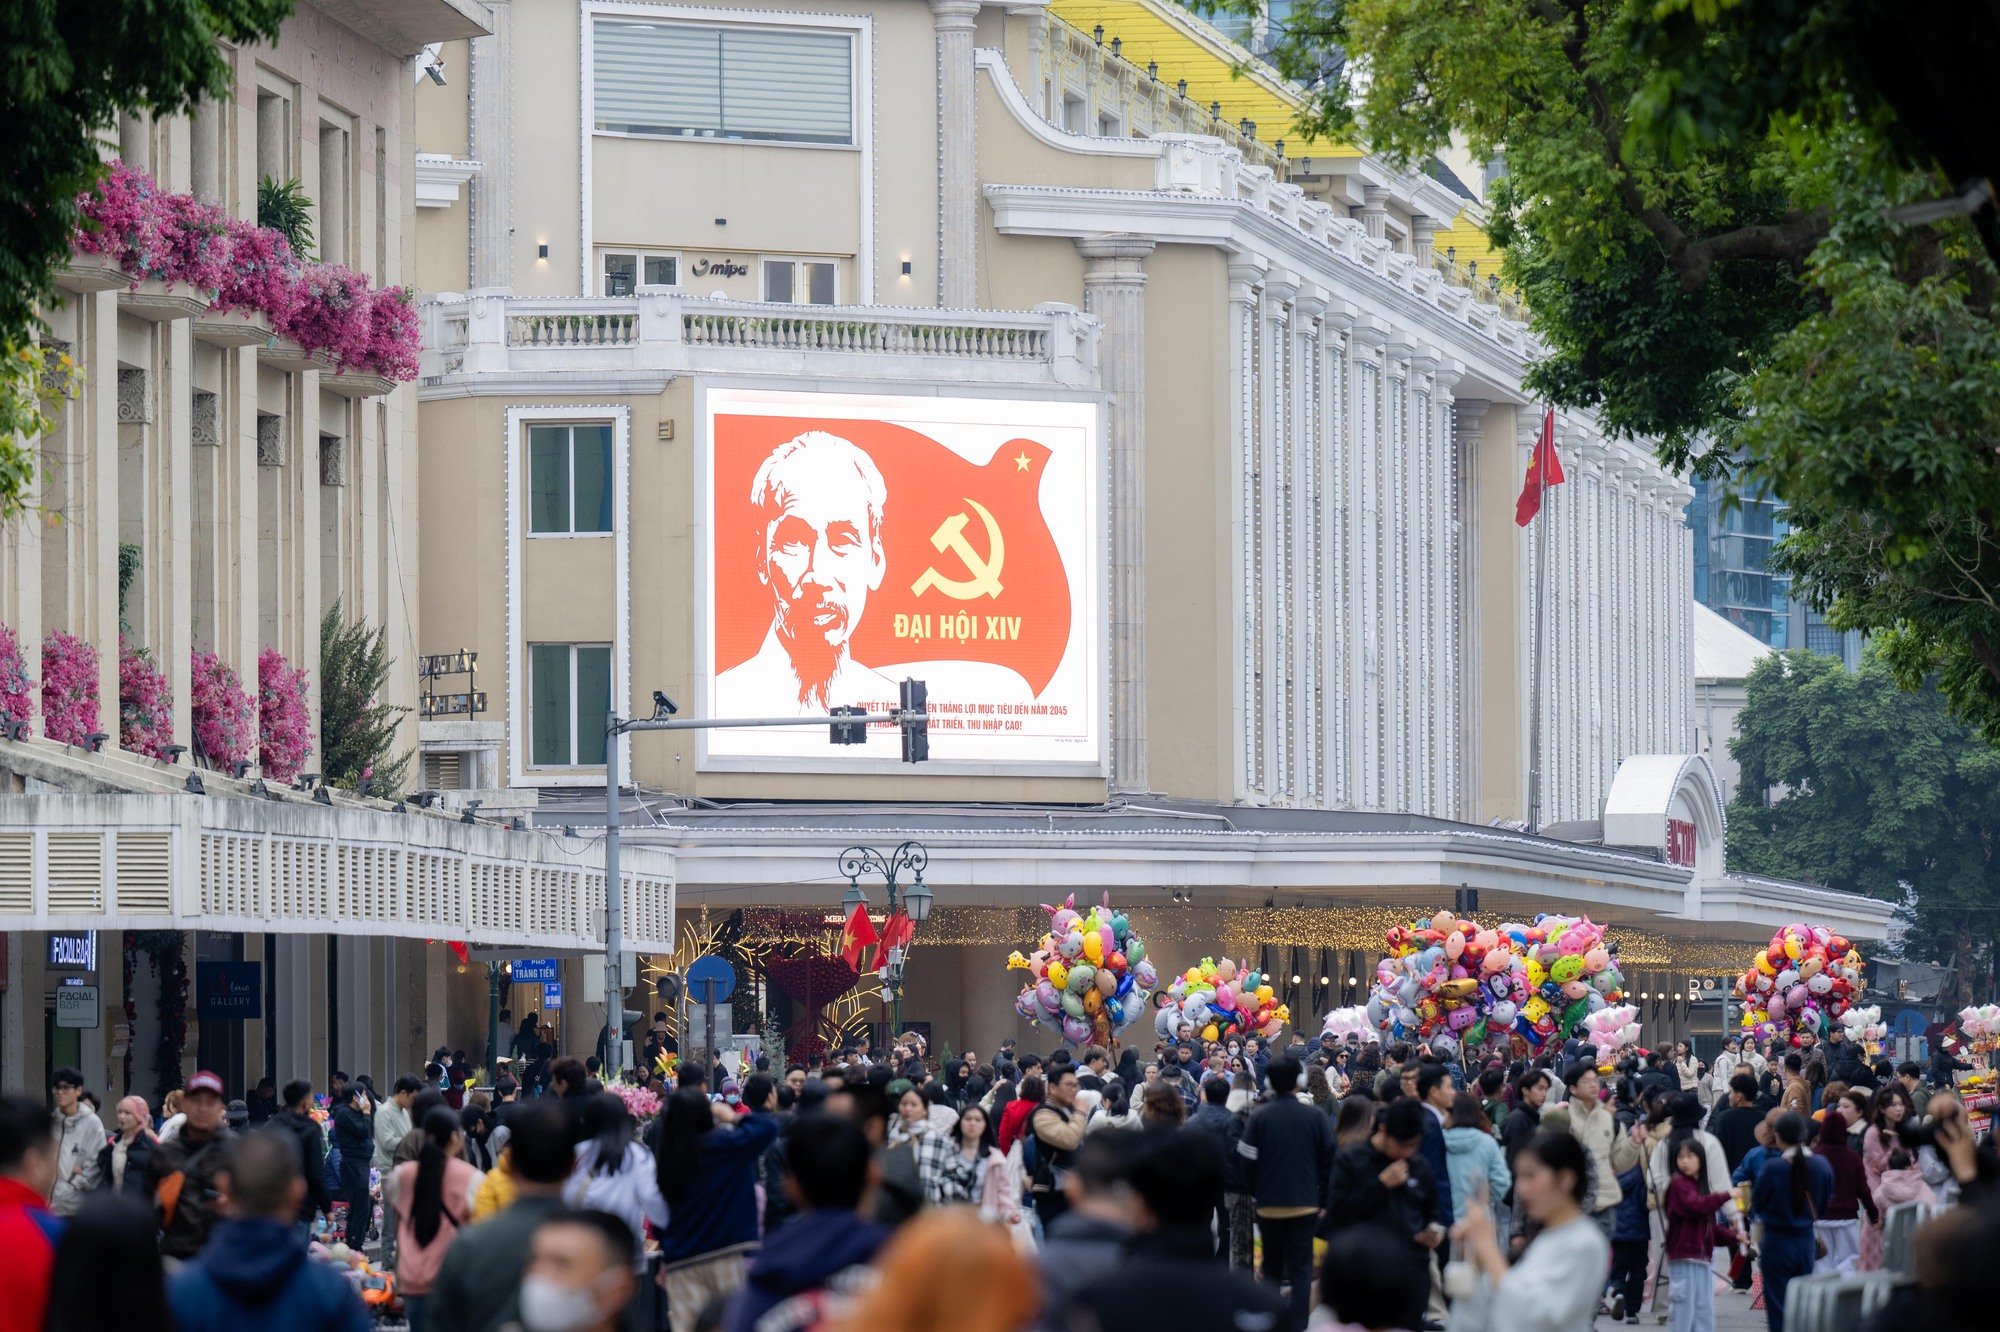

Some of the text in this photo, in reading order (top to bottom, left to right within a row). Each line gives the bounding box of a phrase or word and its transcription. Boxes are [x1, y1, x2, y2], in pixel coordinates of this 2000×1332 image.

[709, 259, 749, 278] mipa
[893, 610, 1022, 645] ĐẠI HỘI XIV
[978, 704, 995, 717] MỤC
[997, 703, 1013, 715] TIÊU
[1031, 703, 1048, 715] NĂM
[1049, 705, 1068, 716] 2045
[967, 719, 981, 730] THU
[1005, 720, 1022, 731] CAO!
[515, 966, 538, 979] TRÀNG
[60, 992, 94, 1001] FACIAL
[210, 997, 251, 1006] GALLERY
[60, 1001, 80, 1010] BAR
